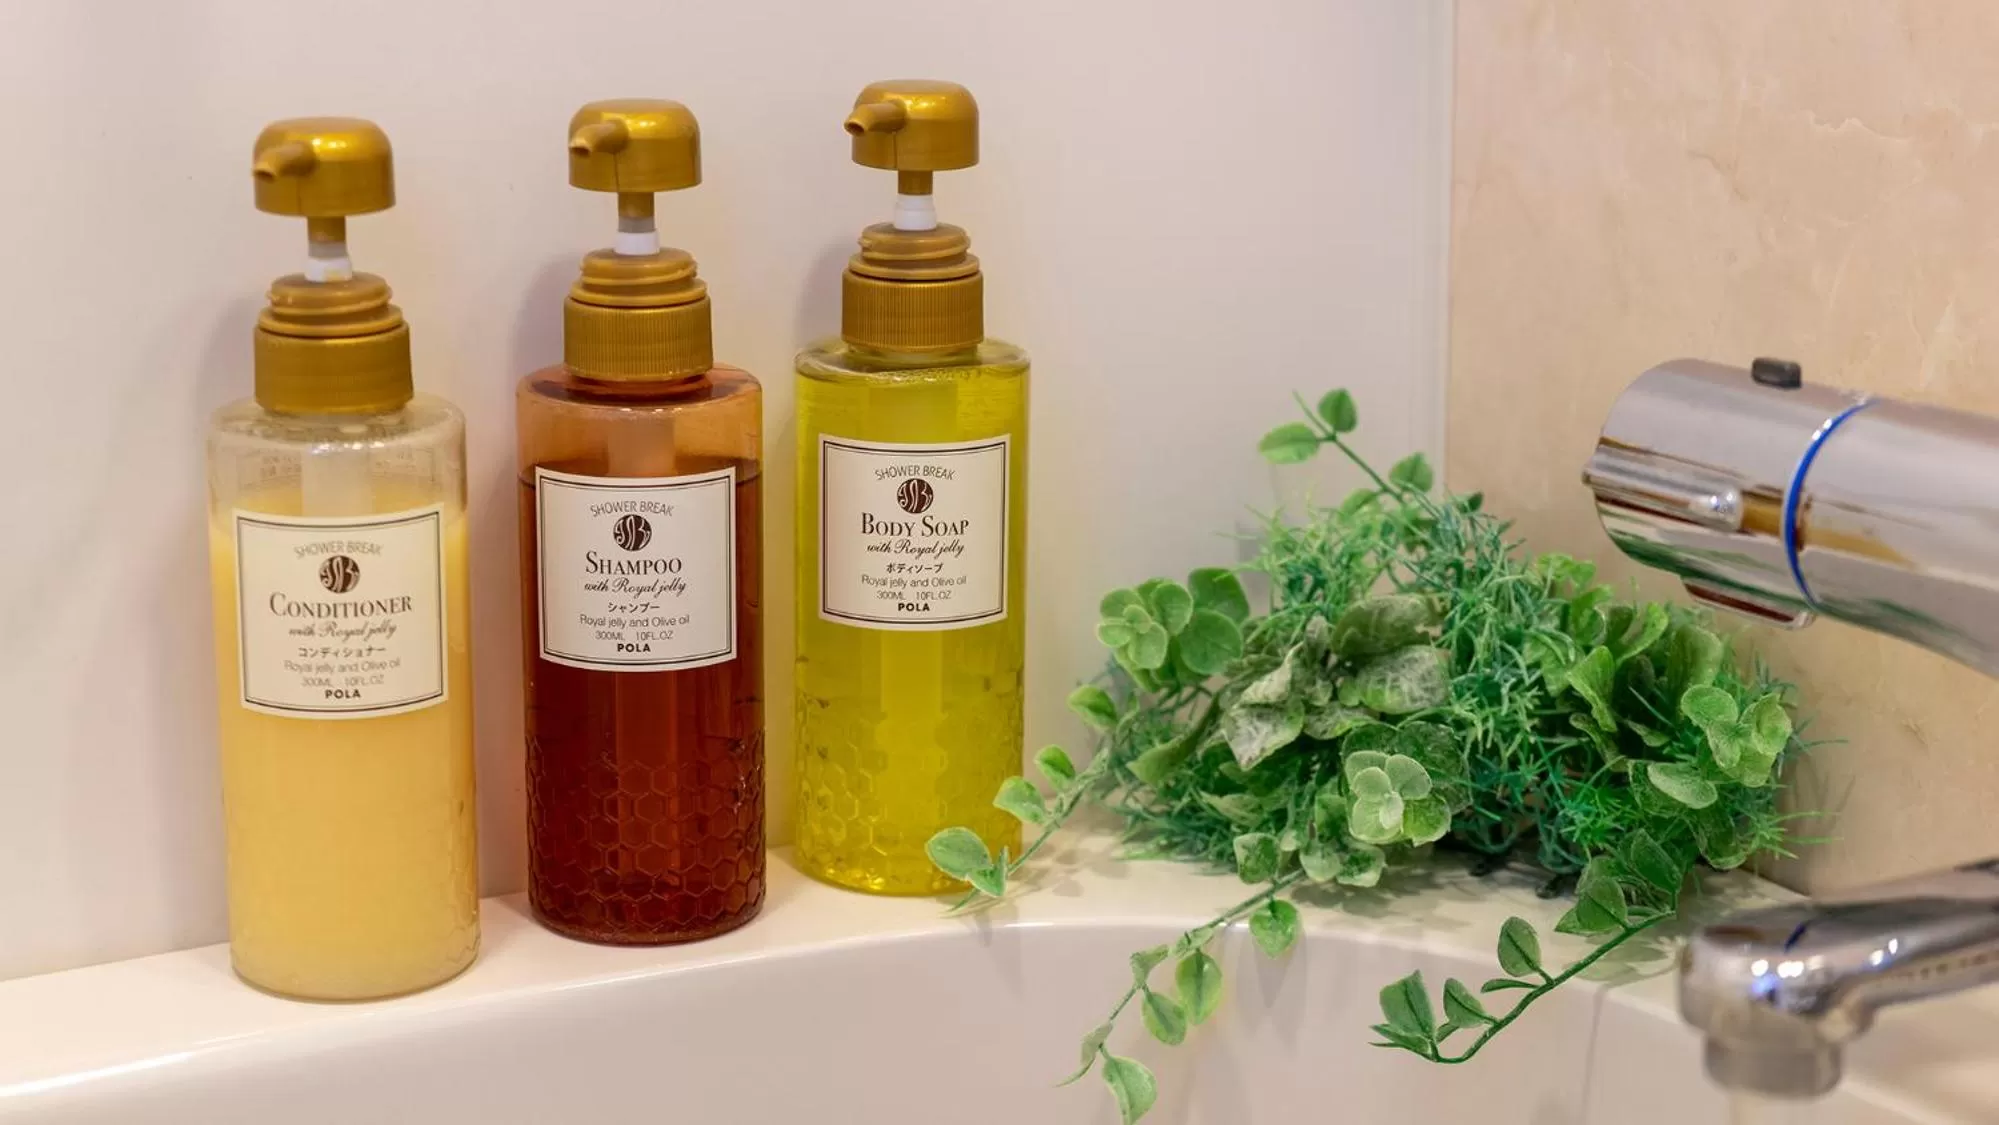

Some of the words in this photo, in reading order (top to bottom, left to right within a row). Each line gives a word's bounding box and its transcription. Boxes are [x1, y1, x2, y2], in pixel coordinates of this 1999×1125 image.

[875, 465, 921, 481] SHOWER
[923, 465, 956, 480] BREAK
[590, 501, 637, 517] SHOWER
[640, 501, 675, 517] BREAK
[294, 541, 345, 559] SHOWER
[347, 541, 384, 556] BREAK
[867, 539, 892, 554] with
[894, 539, 937, 559] Royal
[935, 539, 965, 559] jelly
[886, 563, 944, 574] ボディソープ
[584, 578, 609, 592] with
[612, 577, 656, 598] Royal
[655, 577, 686, 597] jelly
[861, 575, 888, 588] Royal
[889, 576, 907, 588] jelly
[910, 577, 929, 587] and
[931, 576, 955, 587] Olive
[956, 575, 967, 585] oil
[877, 590, 906, 600] 300ML
[608, 602, 660, 613] シャンプー
[898, 603, 930, 611] POLA
[580, 614, 606, 628] Royal
[608, 615, 626, 628] jelly
[629, 616, 649, 627] and
[651, 616, 677, 627] Olive
[679, 614, 690, 625] oil
[289, 622, 315, 637] with
[319, 622, 366, 642] Royal
[365, 620, 397, 642] jelly
[595, 631, 626, 641] 300ML
[298, 646, 387, 658] コンディショナー
[617, 643, 651, 652] POLA
[284, 660, 313, 674] Royal
[315, 661, 335, 674] jelly
[338, 661, 358, 673] and
[361, 659, 387, 672] Olive
[389, 657, 401, 668] oil
[301, 678, 333, 687] 300ML
[325, 689, 361, 699] POLA
